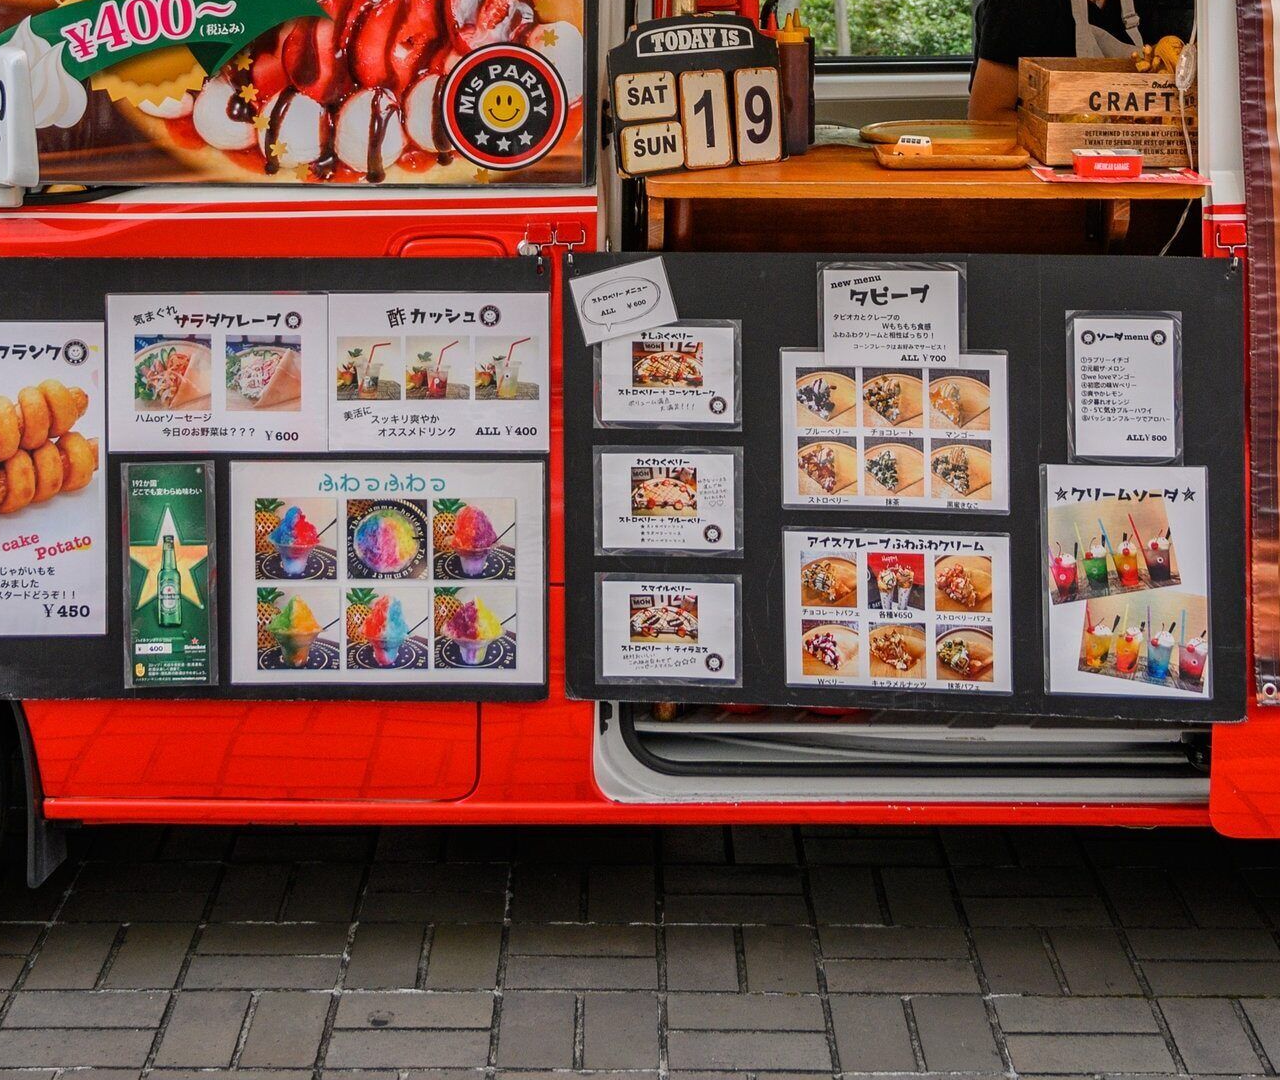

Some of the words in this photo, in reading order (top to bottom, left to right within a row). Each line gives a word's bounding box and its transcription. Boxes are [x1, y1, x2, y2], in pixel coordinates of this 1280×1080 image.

[651, 28, 717, 53] TODAY
[720, 29, 741, 47] IS
[459, 78, 486, 116] M's
[488, 63, 548, 118] PARTY
[627, 84, 669, 106] SAT
[1088, 90, 1175, 112] CRAFT
[693, 89, 716, 149] 1
[744, 85, 773, 145] 9
[633, 134, 677, 158] SUN
[830, 280, 851, 289] new
[853, 274, 882, 285] menu
[850, 283, 930, 307] タピープ
[132, 304, 179, 328] 気まぐれ
[174, 312, 281, 328] サラダクレープ
[881, 322, 932, 331] Wもちもち食感
[135, 412, 213, 423] ハムorソーセージ
[371, 413, 440, 425] スッキリ爽やか
[377, 426, 457, 437] オススメドリンク
[804, 427, 850, 436] ブルーベリー
[870, 428, 914, 437] チョコレート
[945, 431, 976, 440] マンゴー
[318, 473, 446, 492] ふわっふわっ
[808, 496, 849, 505] ストロベリー
[1071, 487, 1179, 502] クリームソーダ
[885, 498, 900, 507] 抹茶
[1, 534, 40, 552] cake
[34, 535, 93, 561] Potato
[802, 608, 860, 618] チョコレートパフェ
[148, 644, 164, 652] 400
